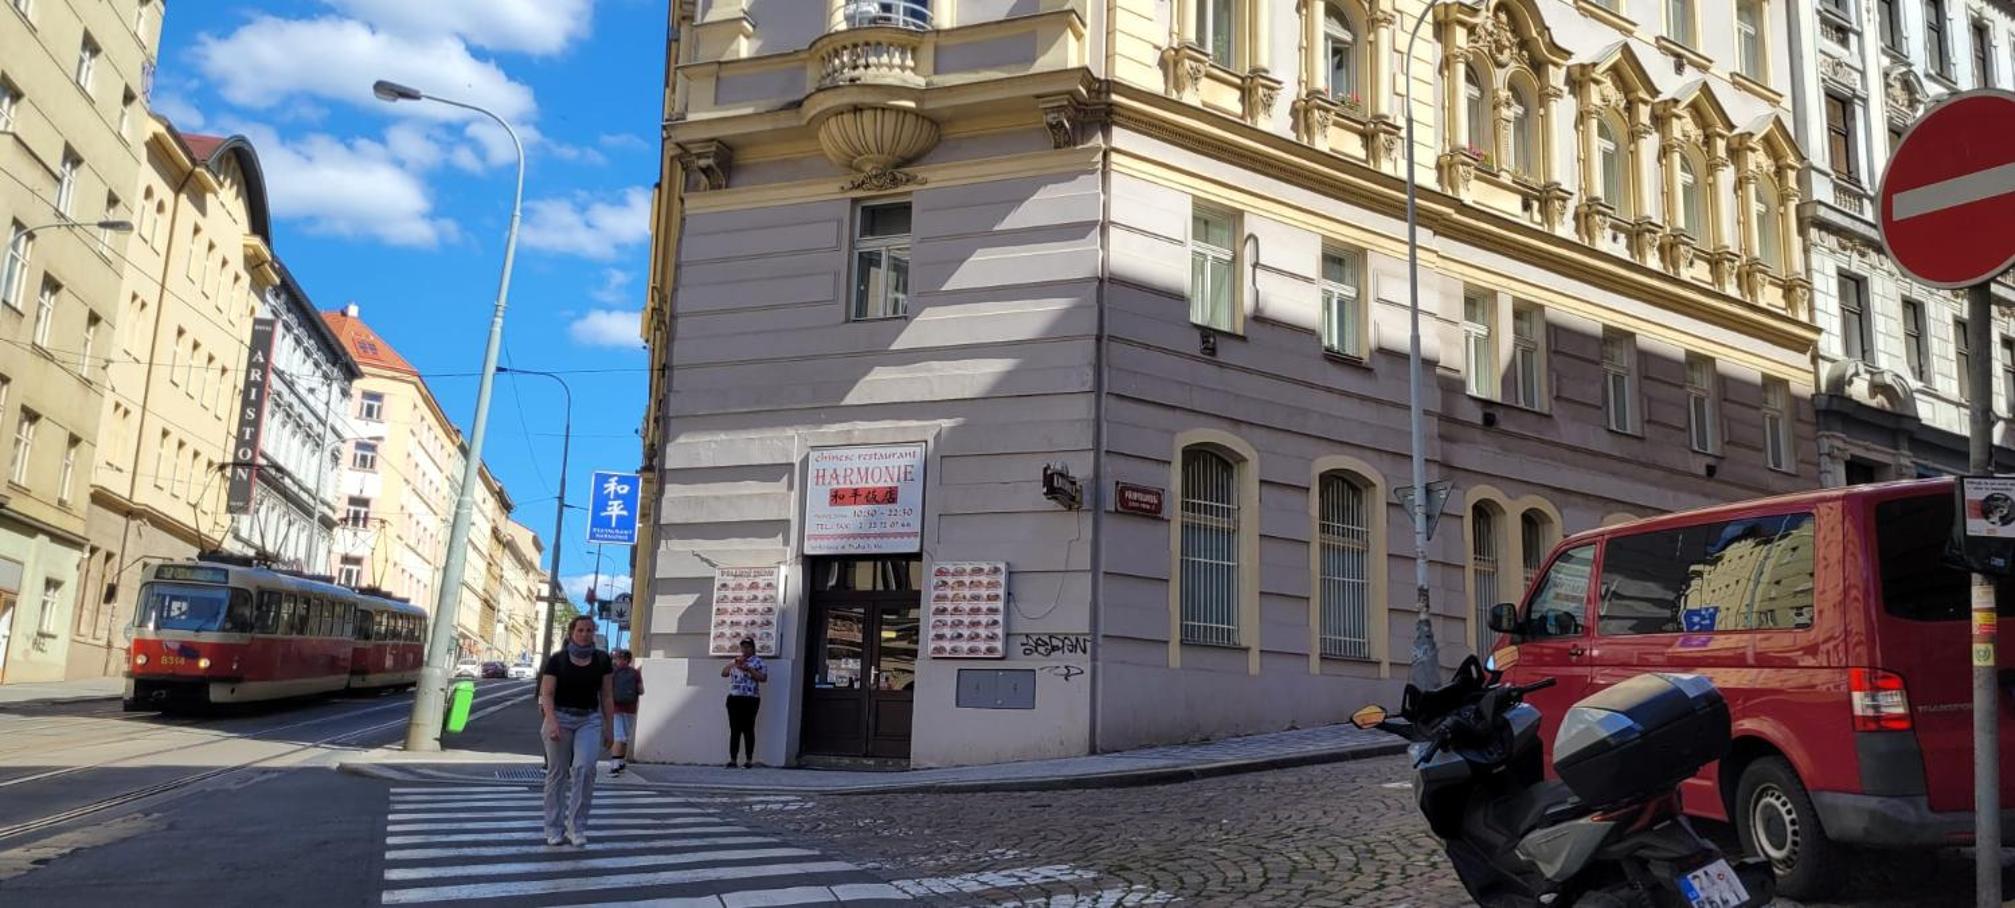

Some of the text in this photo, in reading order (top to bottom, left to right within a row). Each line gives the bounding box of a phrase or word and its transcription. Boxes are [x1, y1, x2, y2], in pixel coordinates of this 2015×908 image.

[235, 350, 265, 481] ARISTON
[858, 450, 916, 461] restaurant
[815, 464, 915, 486] HARMONIE
[600, 476, 630, 528] 和平
